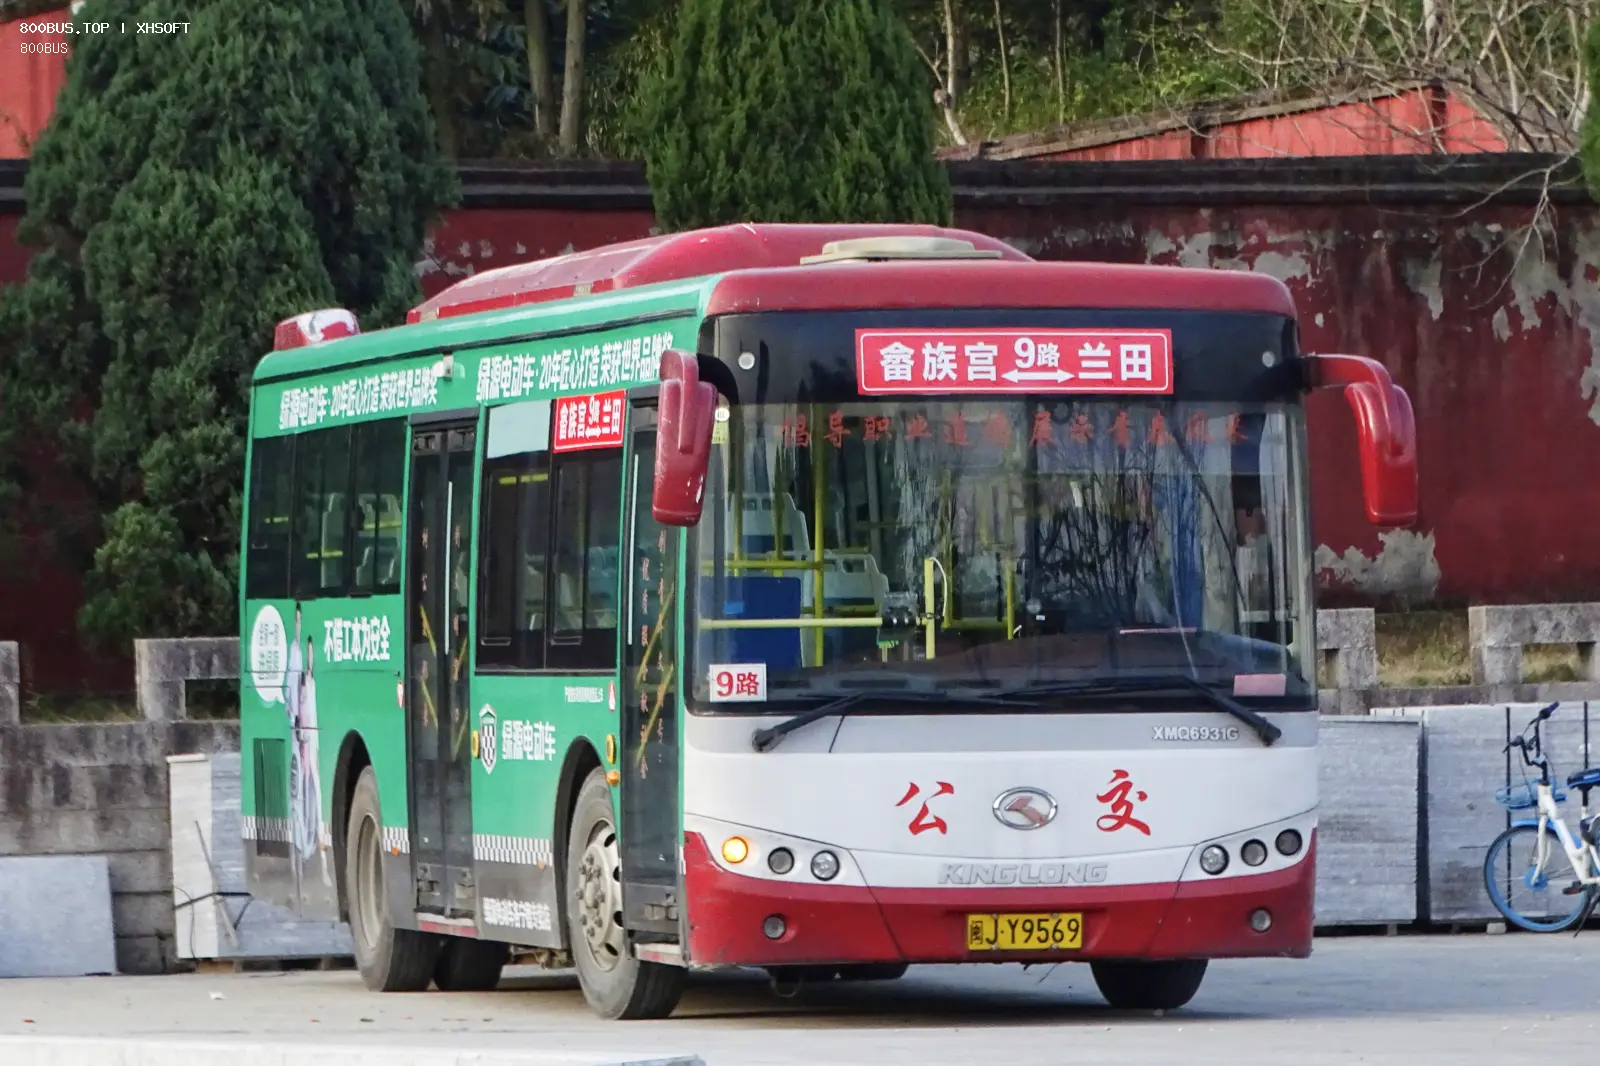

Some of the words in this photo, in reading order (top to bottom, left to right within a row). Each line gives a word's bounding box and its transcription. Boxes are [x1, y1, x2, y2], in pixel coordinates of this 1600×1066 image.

[1014, 337, 1060, 369] 9路
[1078, 342, 1152, 381] 兰田
[716, 671, 760, 697] 9路
[1152, 726, 1239, 741] XMQ6931G
[895, 781, 955, 836] 公
[1096, 769, 1151, 836] 交
